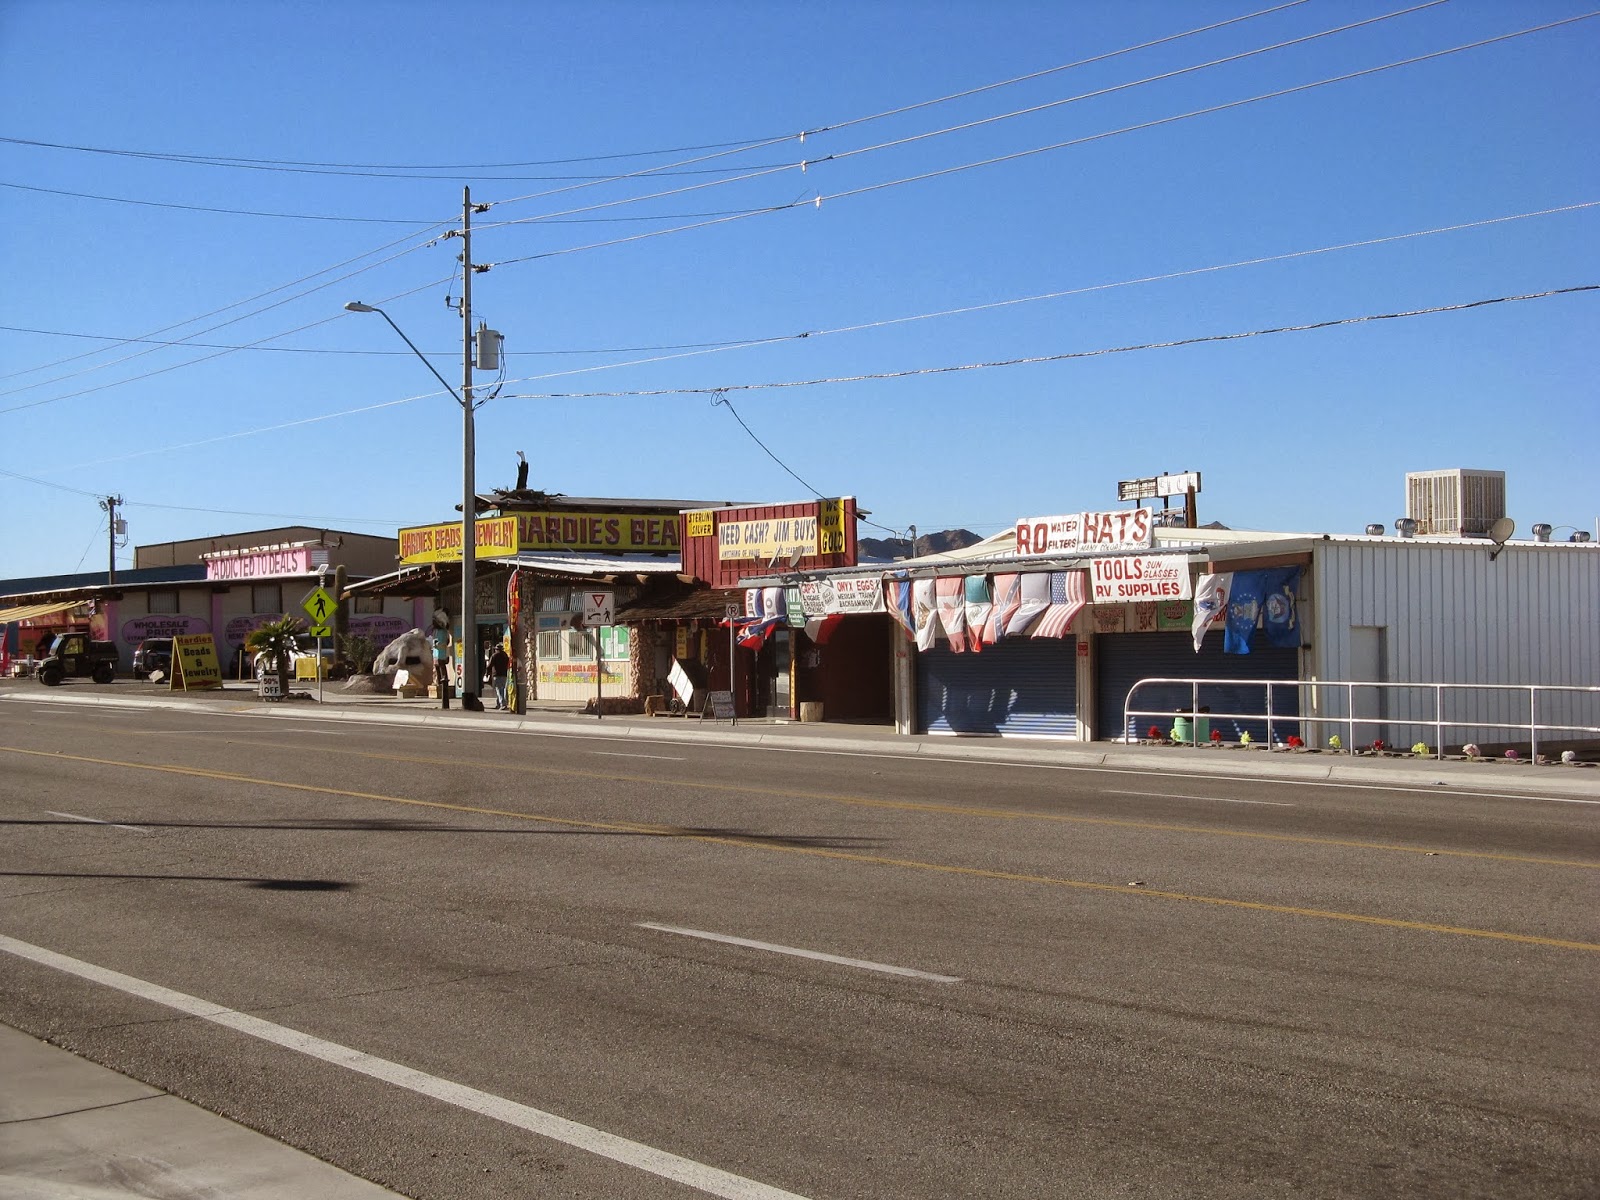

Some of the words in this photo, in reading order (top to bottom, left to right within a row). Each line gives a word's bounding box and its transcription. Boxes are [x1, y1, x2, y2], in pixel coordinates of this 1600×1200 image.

[825, 515, 840, 526] BUY
[1083, 509, 1149, 544] HATS
[518, 516, 620, 545] HARDIES
[630, 518, 681, 546] BEA
[692, 524, 712, 535] SILVER
[719, 524, 740, 546] NEED
[744, 522, 769, 545] CASH?
[774, 520, 790, 543] JIM
[794, 518, 816, 541] BUYS
[1050, 521, 1077, 533] WATER
[401, 529, 433, 558] HARDIES
[434, 527, 461, 551] BEADS
[823, 530, 843, 552] GOLD
[1016, 523, 1049, 555] RO
[1048, 538, 1077, 550] FILTERS
[255, 554, 267, 576] TO
[1094, 558, 1143, 581] TOOLS
[1145, 560, 1163, 570] SUN
[1143, 568, 1179, 578] GLASSES
[836, 581, 853, 593] ONYX
[856, 579, 875, 592] EGGS
[1118, 582, 1180, 597] SUPPLIES
[134, 620, 189, 629] WHOLESALE
[177, 636, 213, 644] Hardies
[183, 647, 211, 656] Beads
[196, 658, 203, 667] &
[263, 677, 279, 685] 50%
[263, 686, 279, 694] OFF
